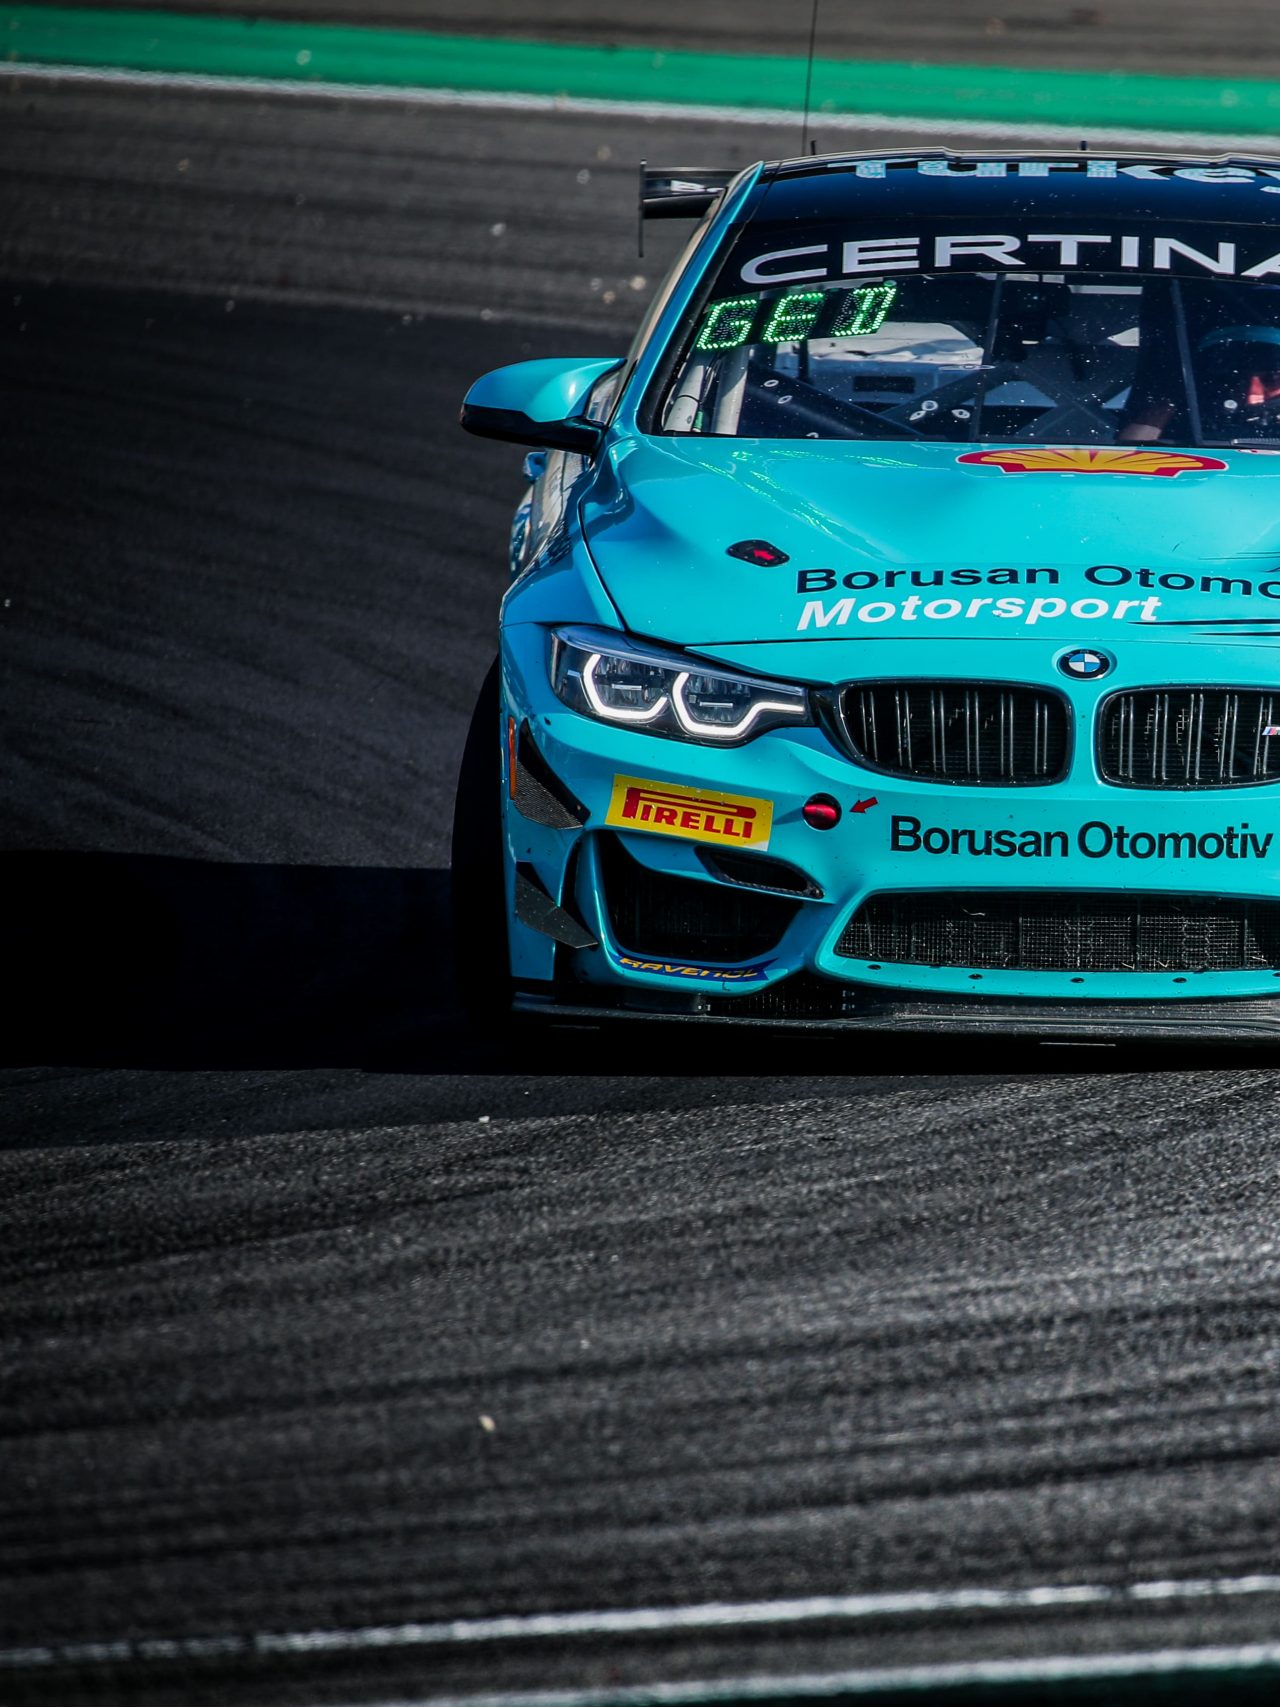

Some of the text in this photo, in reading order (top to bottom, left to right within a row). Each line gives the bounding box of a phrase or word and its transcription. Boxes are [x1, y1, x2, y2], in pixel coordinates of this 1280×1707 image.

[796, 564, 1060, 594] Borusan
[796, 594, 1164, 631] Motorsport
[622, 787, 757, 839] PIRELLI
[890, 814, 1274, 860] Borusan Otomotiv
